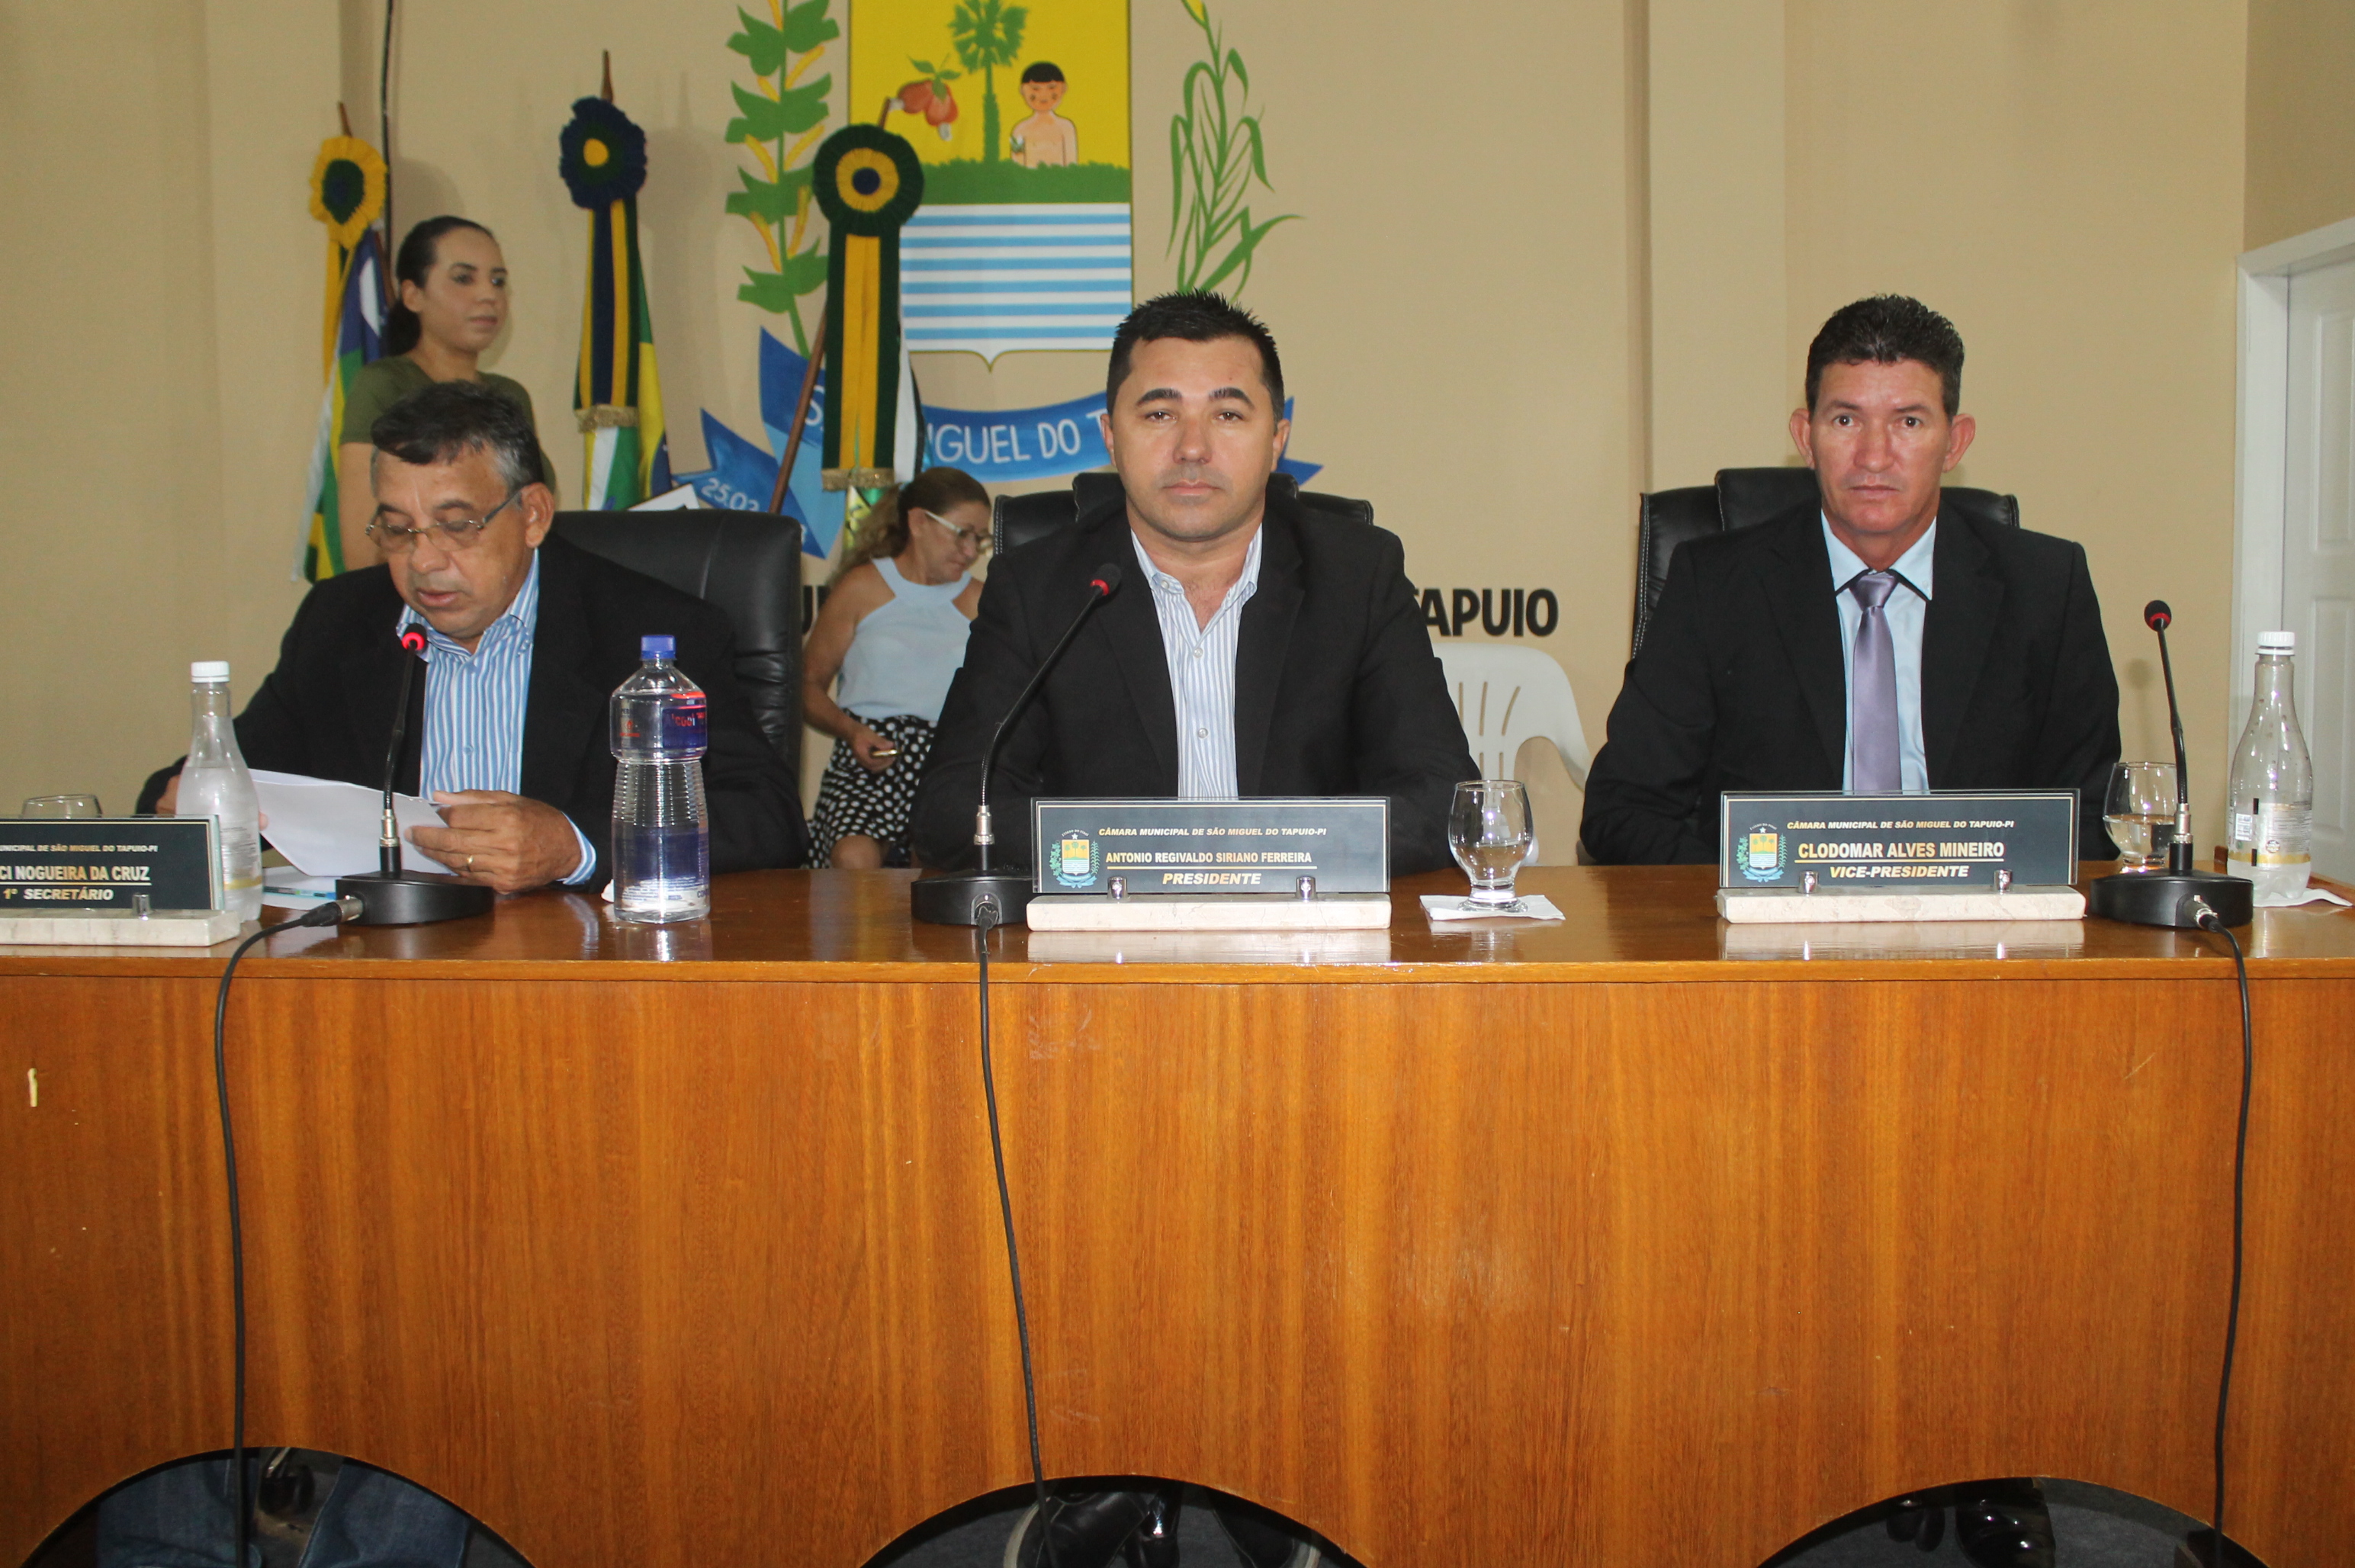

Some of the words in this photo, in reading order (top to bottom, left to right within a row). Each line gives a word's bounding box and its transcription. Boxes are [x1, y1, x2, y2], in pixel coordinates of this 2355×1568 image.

[927, 422, 1030, 464] IGUEL
[1038, 419, 1081, 459] DO
[1415, 588, 1559, 638] APUIO
[1787, 821, 1826, 830] CÂMARA
[1894, 820, 1914, 829] SÃO
[1098, 827, 1138, 837] CÂMARA
[1206, 827, 1226, 836] SÃO
[50, 843, 68, 852] SÃO
[1798, 842, 1884, 859] CLODOMAR
[1886, 842, 1936, 858] ALVES
[1939, 841, 2004, 857] MINEIRO
[1106, 852, 1152, 863] ANTONIO
[1155, 852, 1213, 863] REGIVALDO
[1216, 852, 1258, 863] SIRIANO
[1261, 852, 1312, 863] FERREIRA
[0, 866, 12, 880] CI
[15, 866, 88, 880] NOGUEIRA
[89, 866, 109, 881] DA
[111, 866, 151, 882] CRUZ
[1162, 872, 1262, 885] PRESIDENTE
[1830, 866, 1970, 879] VICE-PRESIDENTE
[24, 886, 114, 901] SECRETÁRIO
